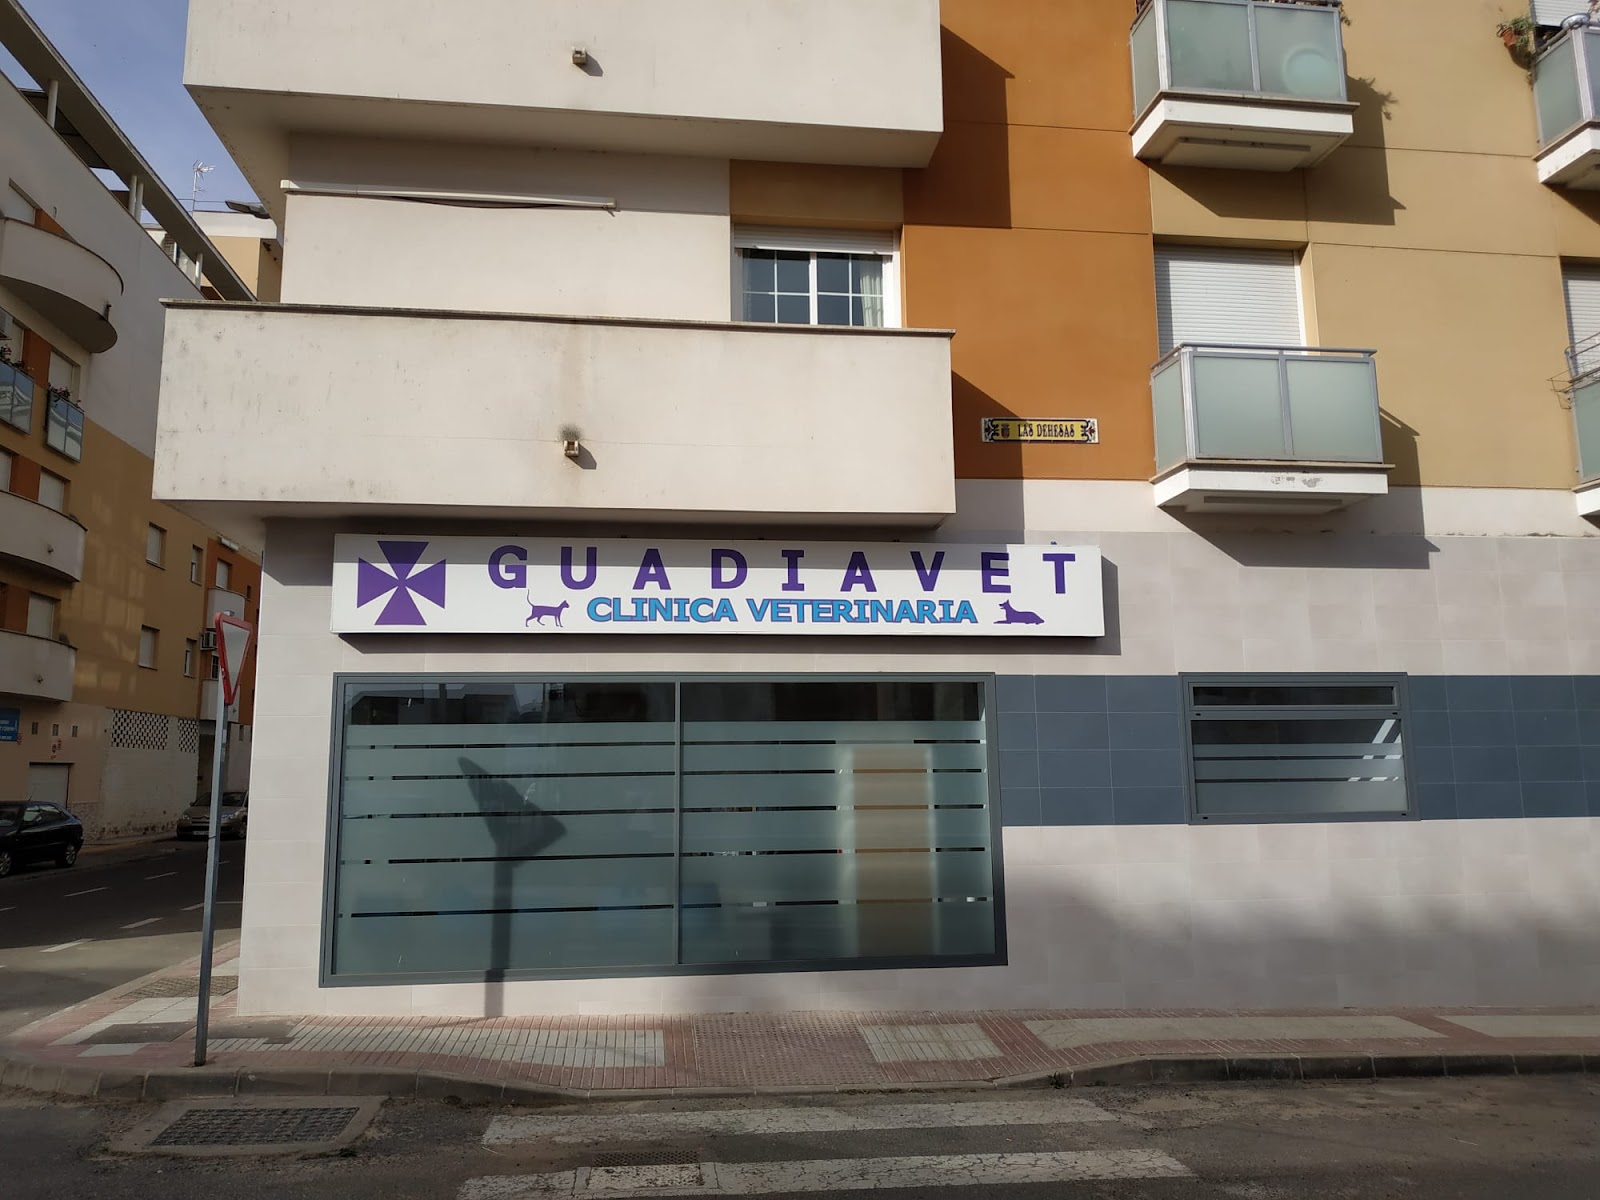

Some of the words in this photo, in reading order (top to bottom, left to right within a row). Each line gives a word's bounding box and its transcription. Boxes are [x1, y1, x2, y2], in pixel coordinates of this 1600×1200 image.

[1017, 423, 1034, 438] LAS
[1036, 423, 1075, 438] DEHESAS
[488, 545, 1076, 594] GUADIAVET
[587, 597, 738, 623] CLINICA
[746, 598, 978, 624] VETERINARIA
